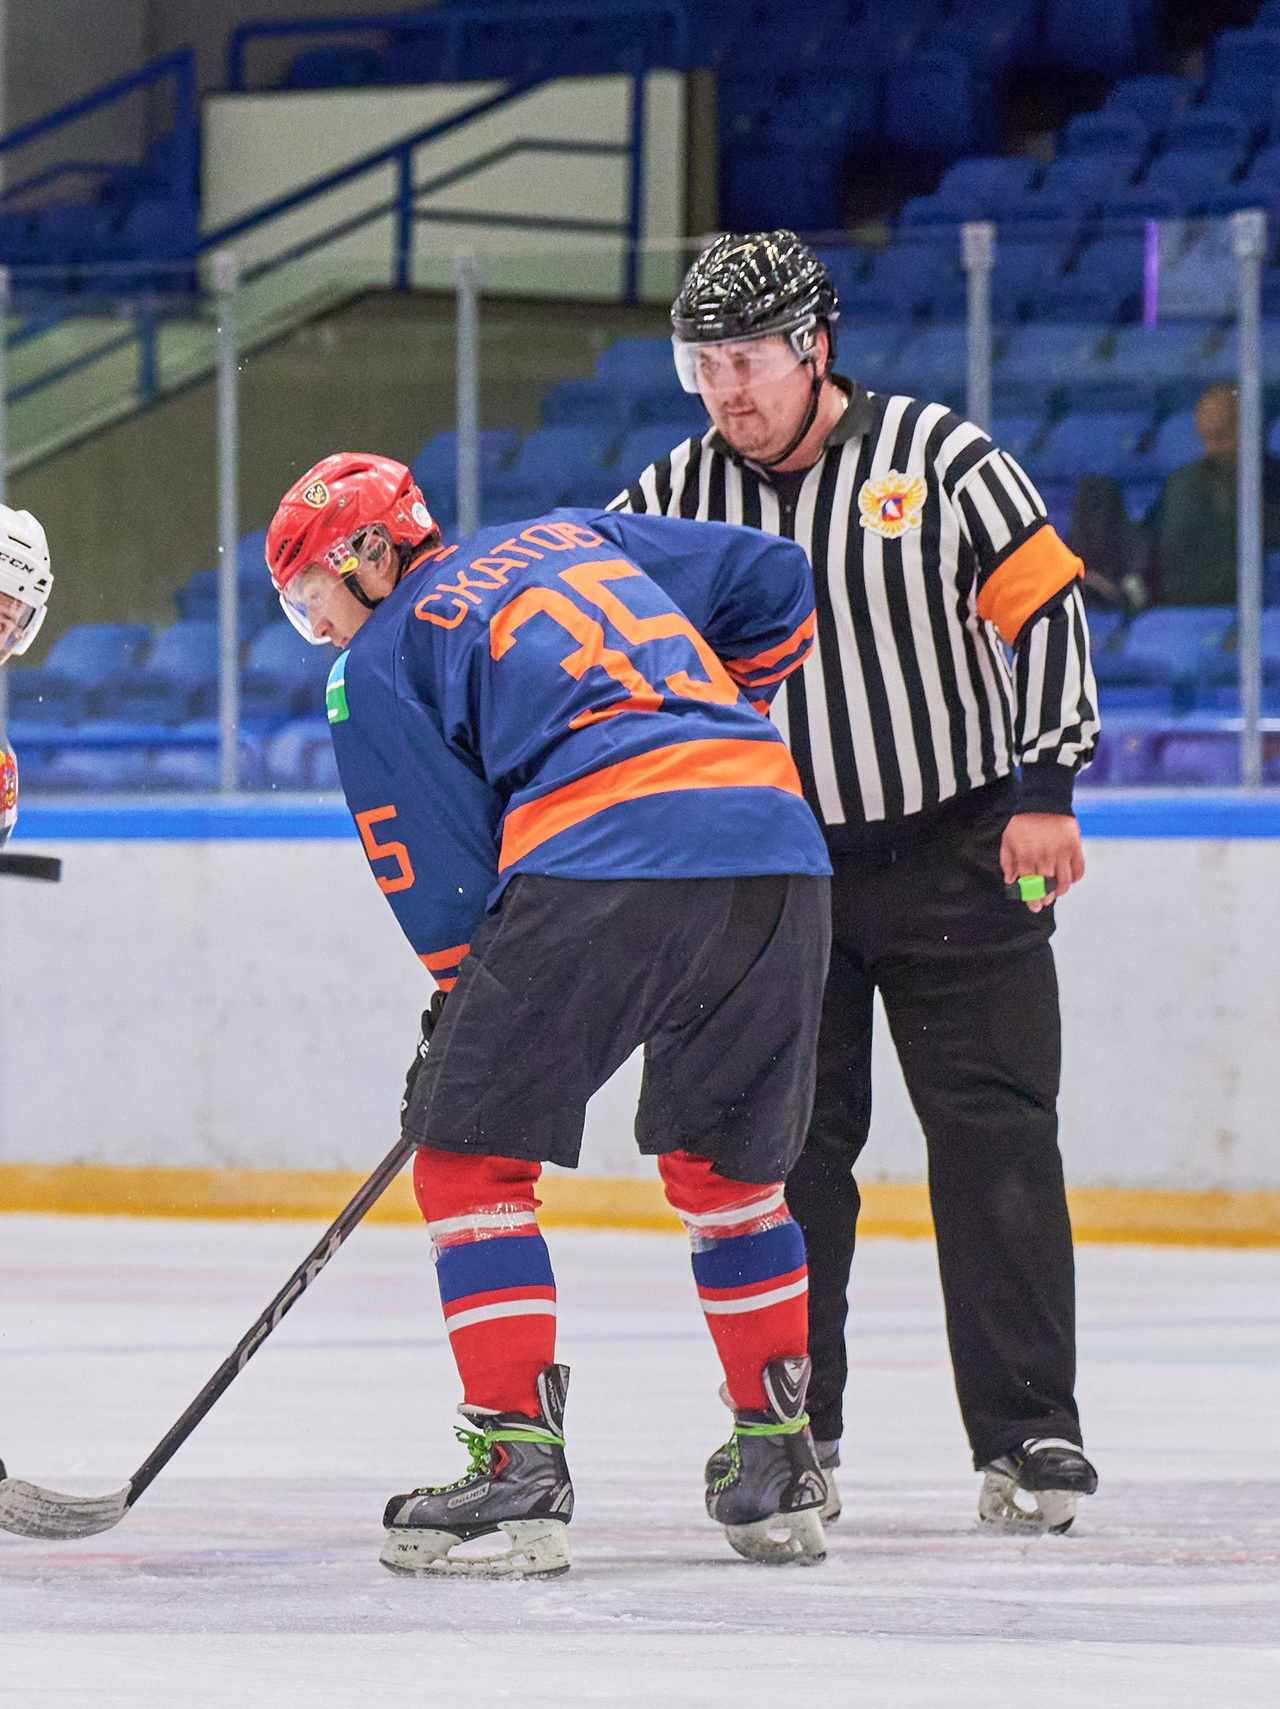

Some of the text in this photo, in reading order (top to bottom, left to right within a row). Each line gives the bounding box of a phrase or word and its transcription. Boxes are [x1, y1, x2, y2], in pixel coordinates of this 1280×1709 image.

[414, 522, 604, 630] СКАТОВ
[489, 559, 739, 731] 35
[355, 804, 416, 895] 5
